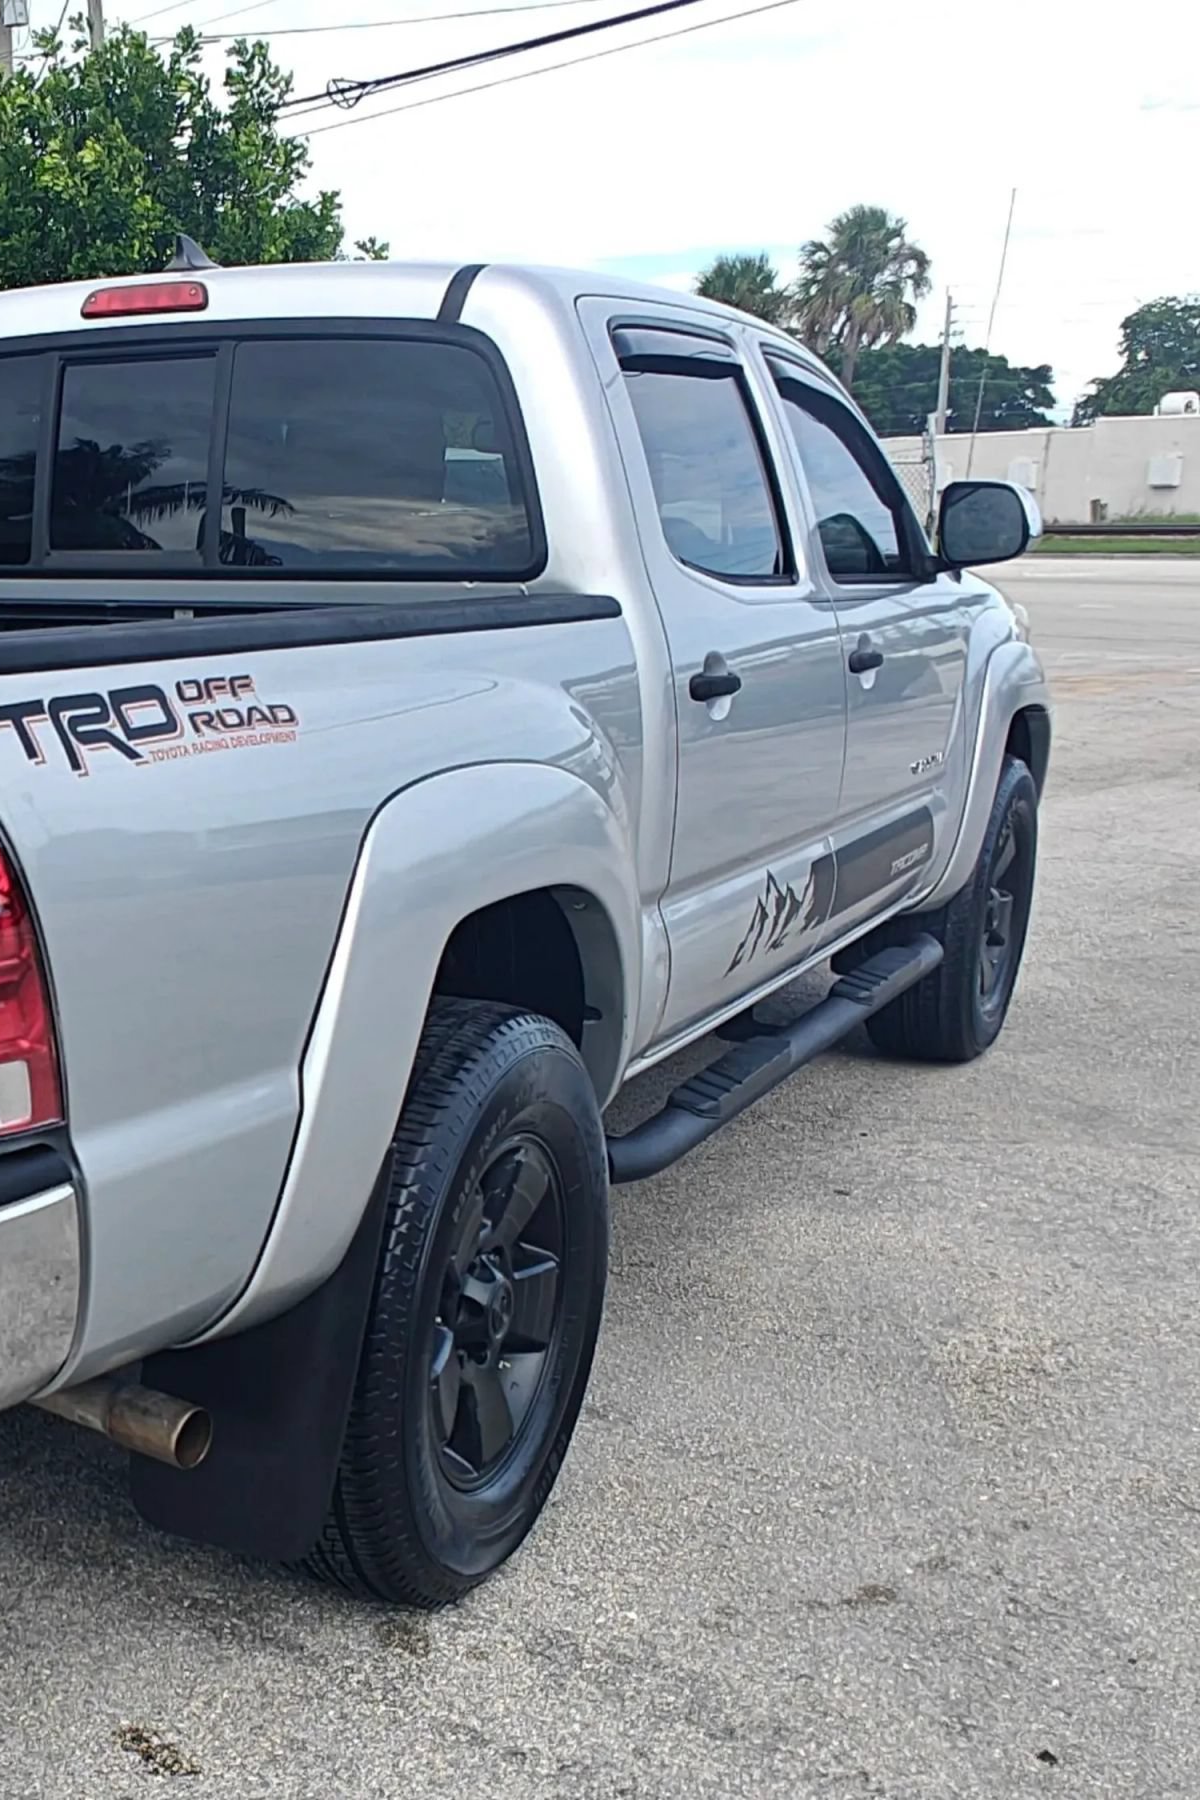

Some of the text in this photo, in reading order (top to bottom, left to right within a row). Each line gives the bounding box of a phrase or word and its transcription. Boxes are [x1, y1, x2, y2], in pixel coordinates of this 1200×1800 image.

[175, 674, 256, 706] OFF
[188, 703, 299, 737] ROAD
[148, 730, 297, 763] TOYOTA RACING DEVELOPMENT
